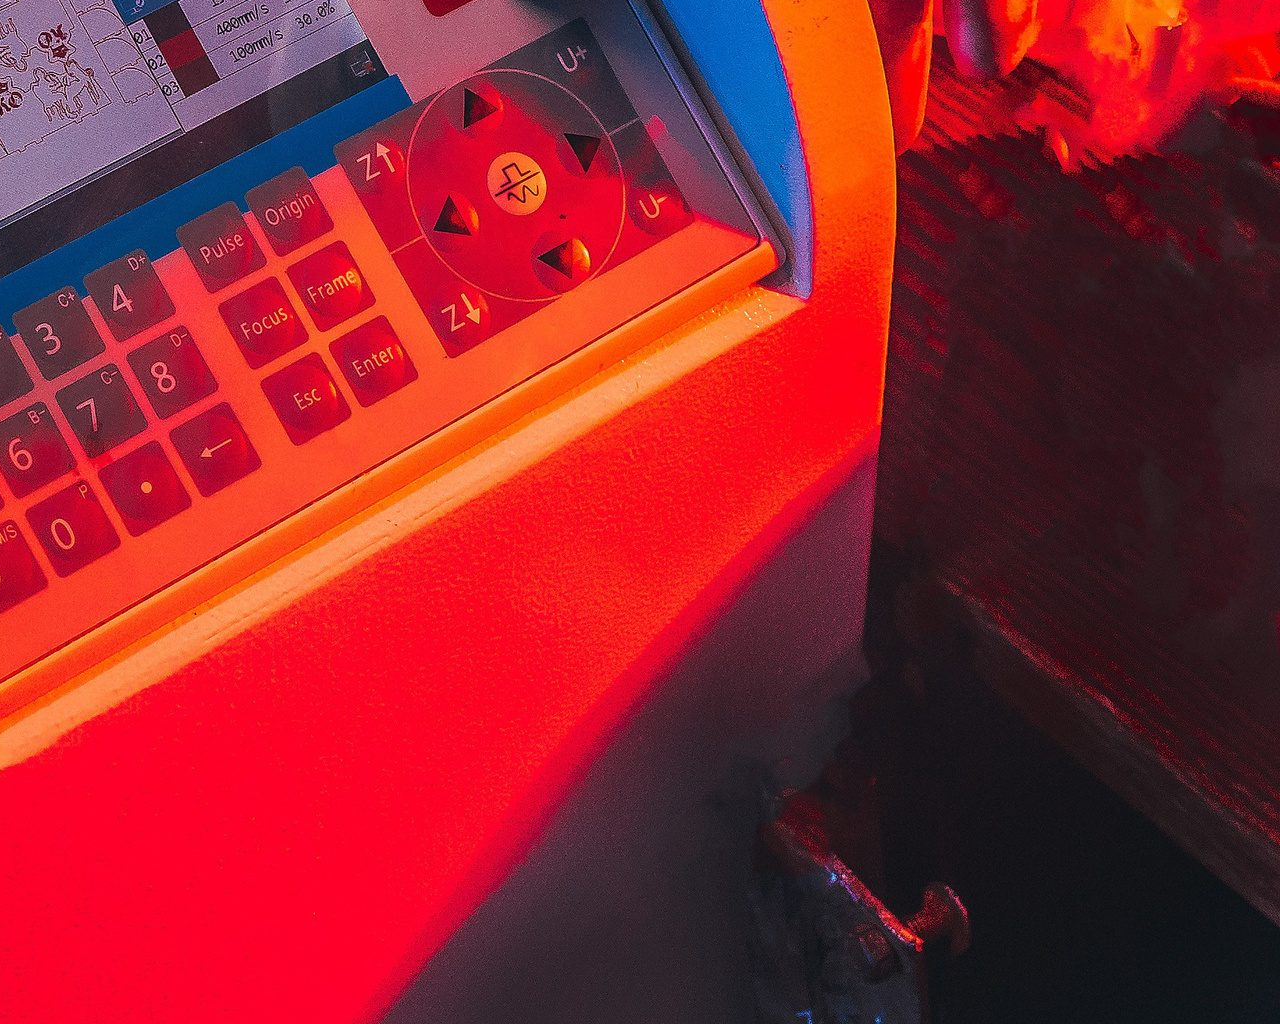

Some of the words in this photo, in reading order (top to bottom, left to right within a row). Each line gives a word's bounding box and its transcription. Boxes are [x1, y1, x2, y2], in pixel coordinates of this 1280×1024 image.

[133, 28, 152, 46] 01
[147, 54, 166, 72] 02
[215, 3, 269, 35] 400mm/s
[161, 81, 180, 99] 03
[228, 28, 284, 63] 100mm/s
[555, 45, 587, 73] U+
[264, 193, 314, 226] Origin
[126, 254, 146, 271] D+
[198, 233, 244, 264] Pulse
[56, 291, 75, 307] C+
[112, 283, 132, 312] 4
[305, 269, 362, 303] Frame
[34, 322, 61, 355] 3
[239, 306, 288, 340] Focus
[149, 360, 176, 393] 8
[350, 345, 394, 377] Enter
[292, 387, 322, 410] Esc
[74, 397, 105, 435] 7
[7, 437, 33, 470] 6
[77, 483, 88, 499] P
[49, 517, 76, 550] 0
